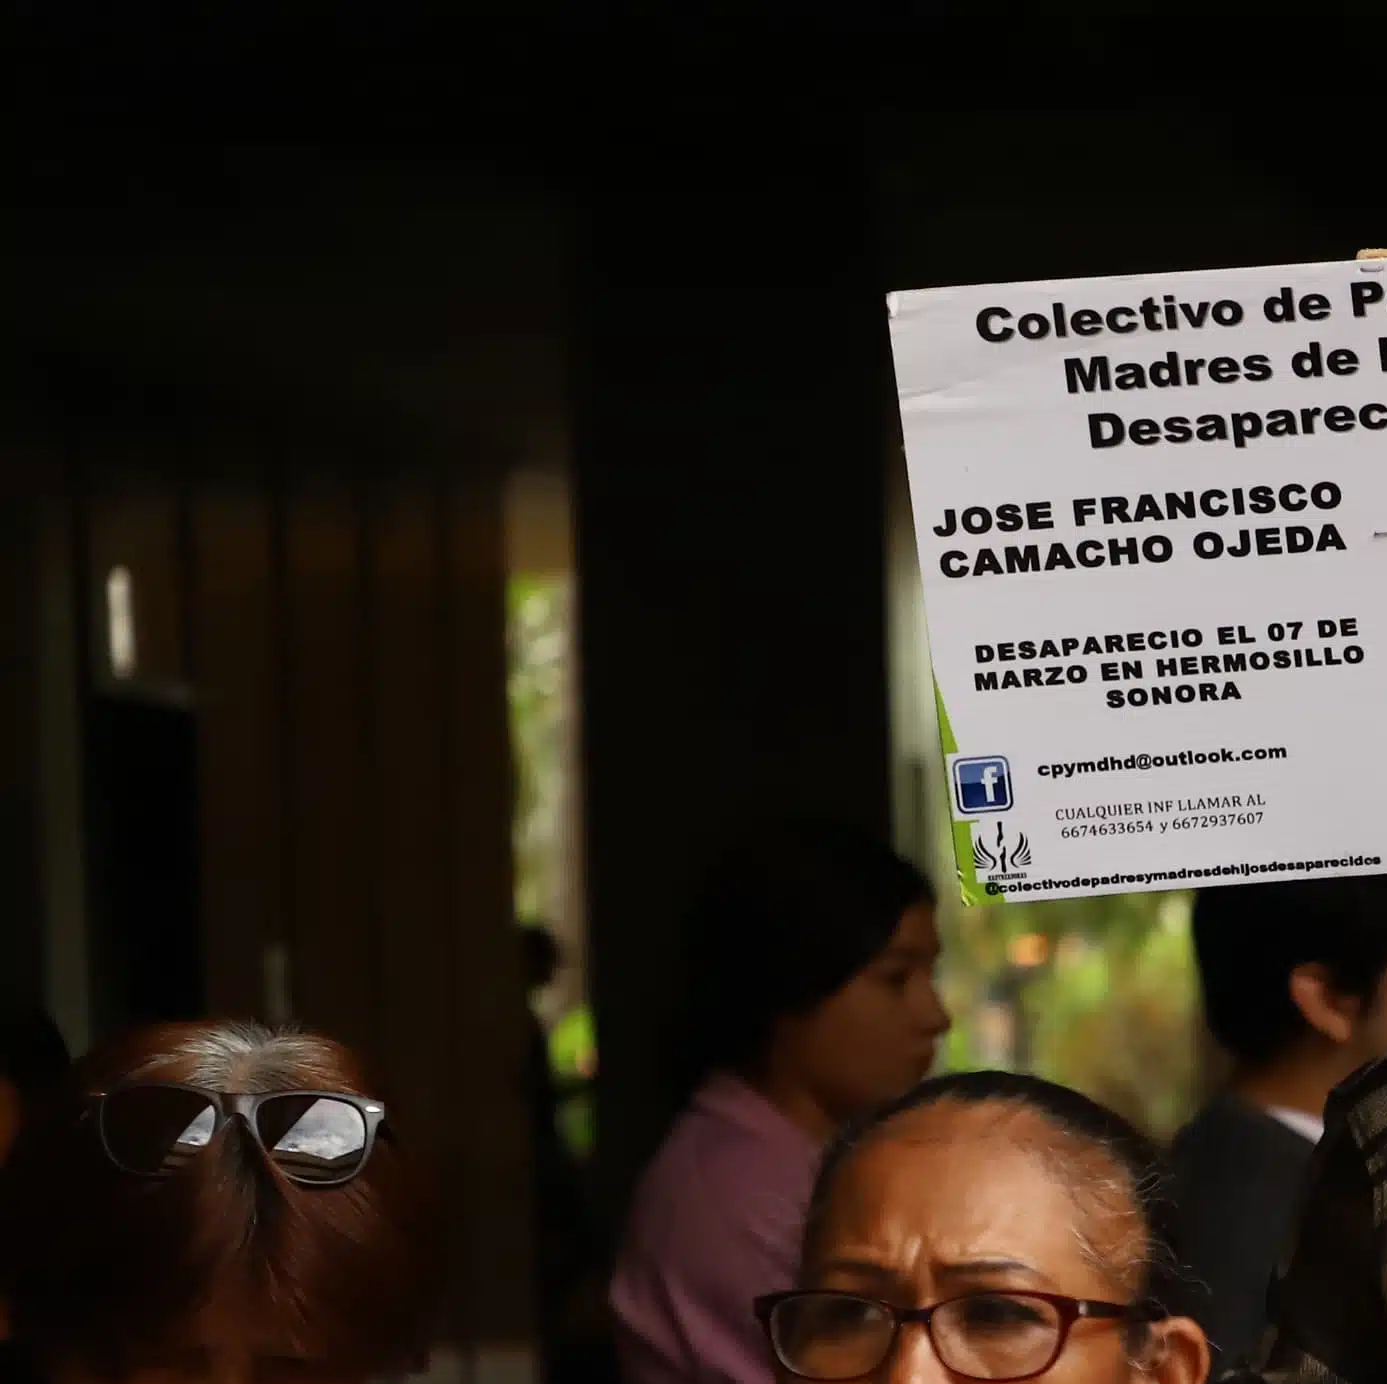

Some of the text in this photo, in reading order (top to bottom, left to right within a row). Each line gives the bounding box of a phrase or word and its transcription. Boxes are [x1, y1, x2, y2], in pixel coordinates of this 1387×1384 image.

[976, 293, 1244, 342] Colectivo
[1264, 287, 1331, 322] de
[1065, 351, 1273, 393] Madres
[1291, 342, 1359, 377] de
[933, 481, 1342, 537] JOSE FRANCISCO
[940, 523, 1346, 577] CAMACHO OJEDA
[975, 618, 1359, 663] DESAPARECIO EL 07 DE
[974, 645, 1364, 691] MARZO EN HERMOSILLO
[1106, 681, 1242, 709] SONORA
[1037, 744, 1288, 779] cpymdhd@outlook.com
[1055, 793, 1267, 823] CUALQUIER INF LLAMAR AL
[1061, 811, 1264, 839] 6674633654 y 6672937607
[985, 854, 1382, 895] @colectivodepadresymadresdehijosdesaparecidos
